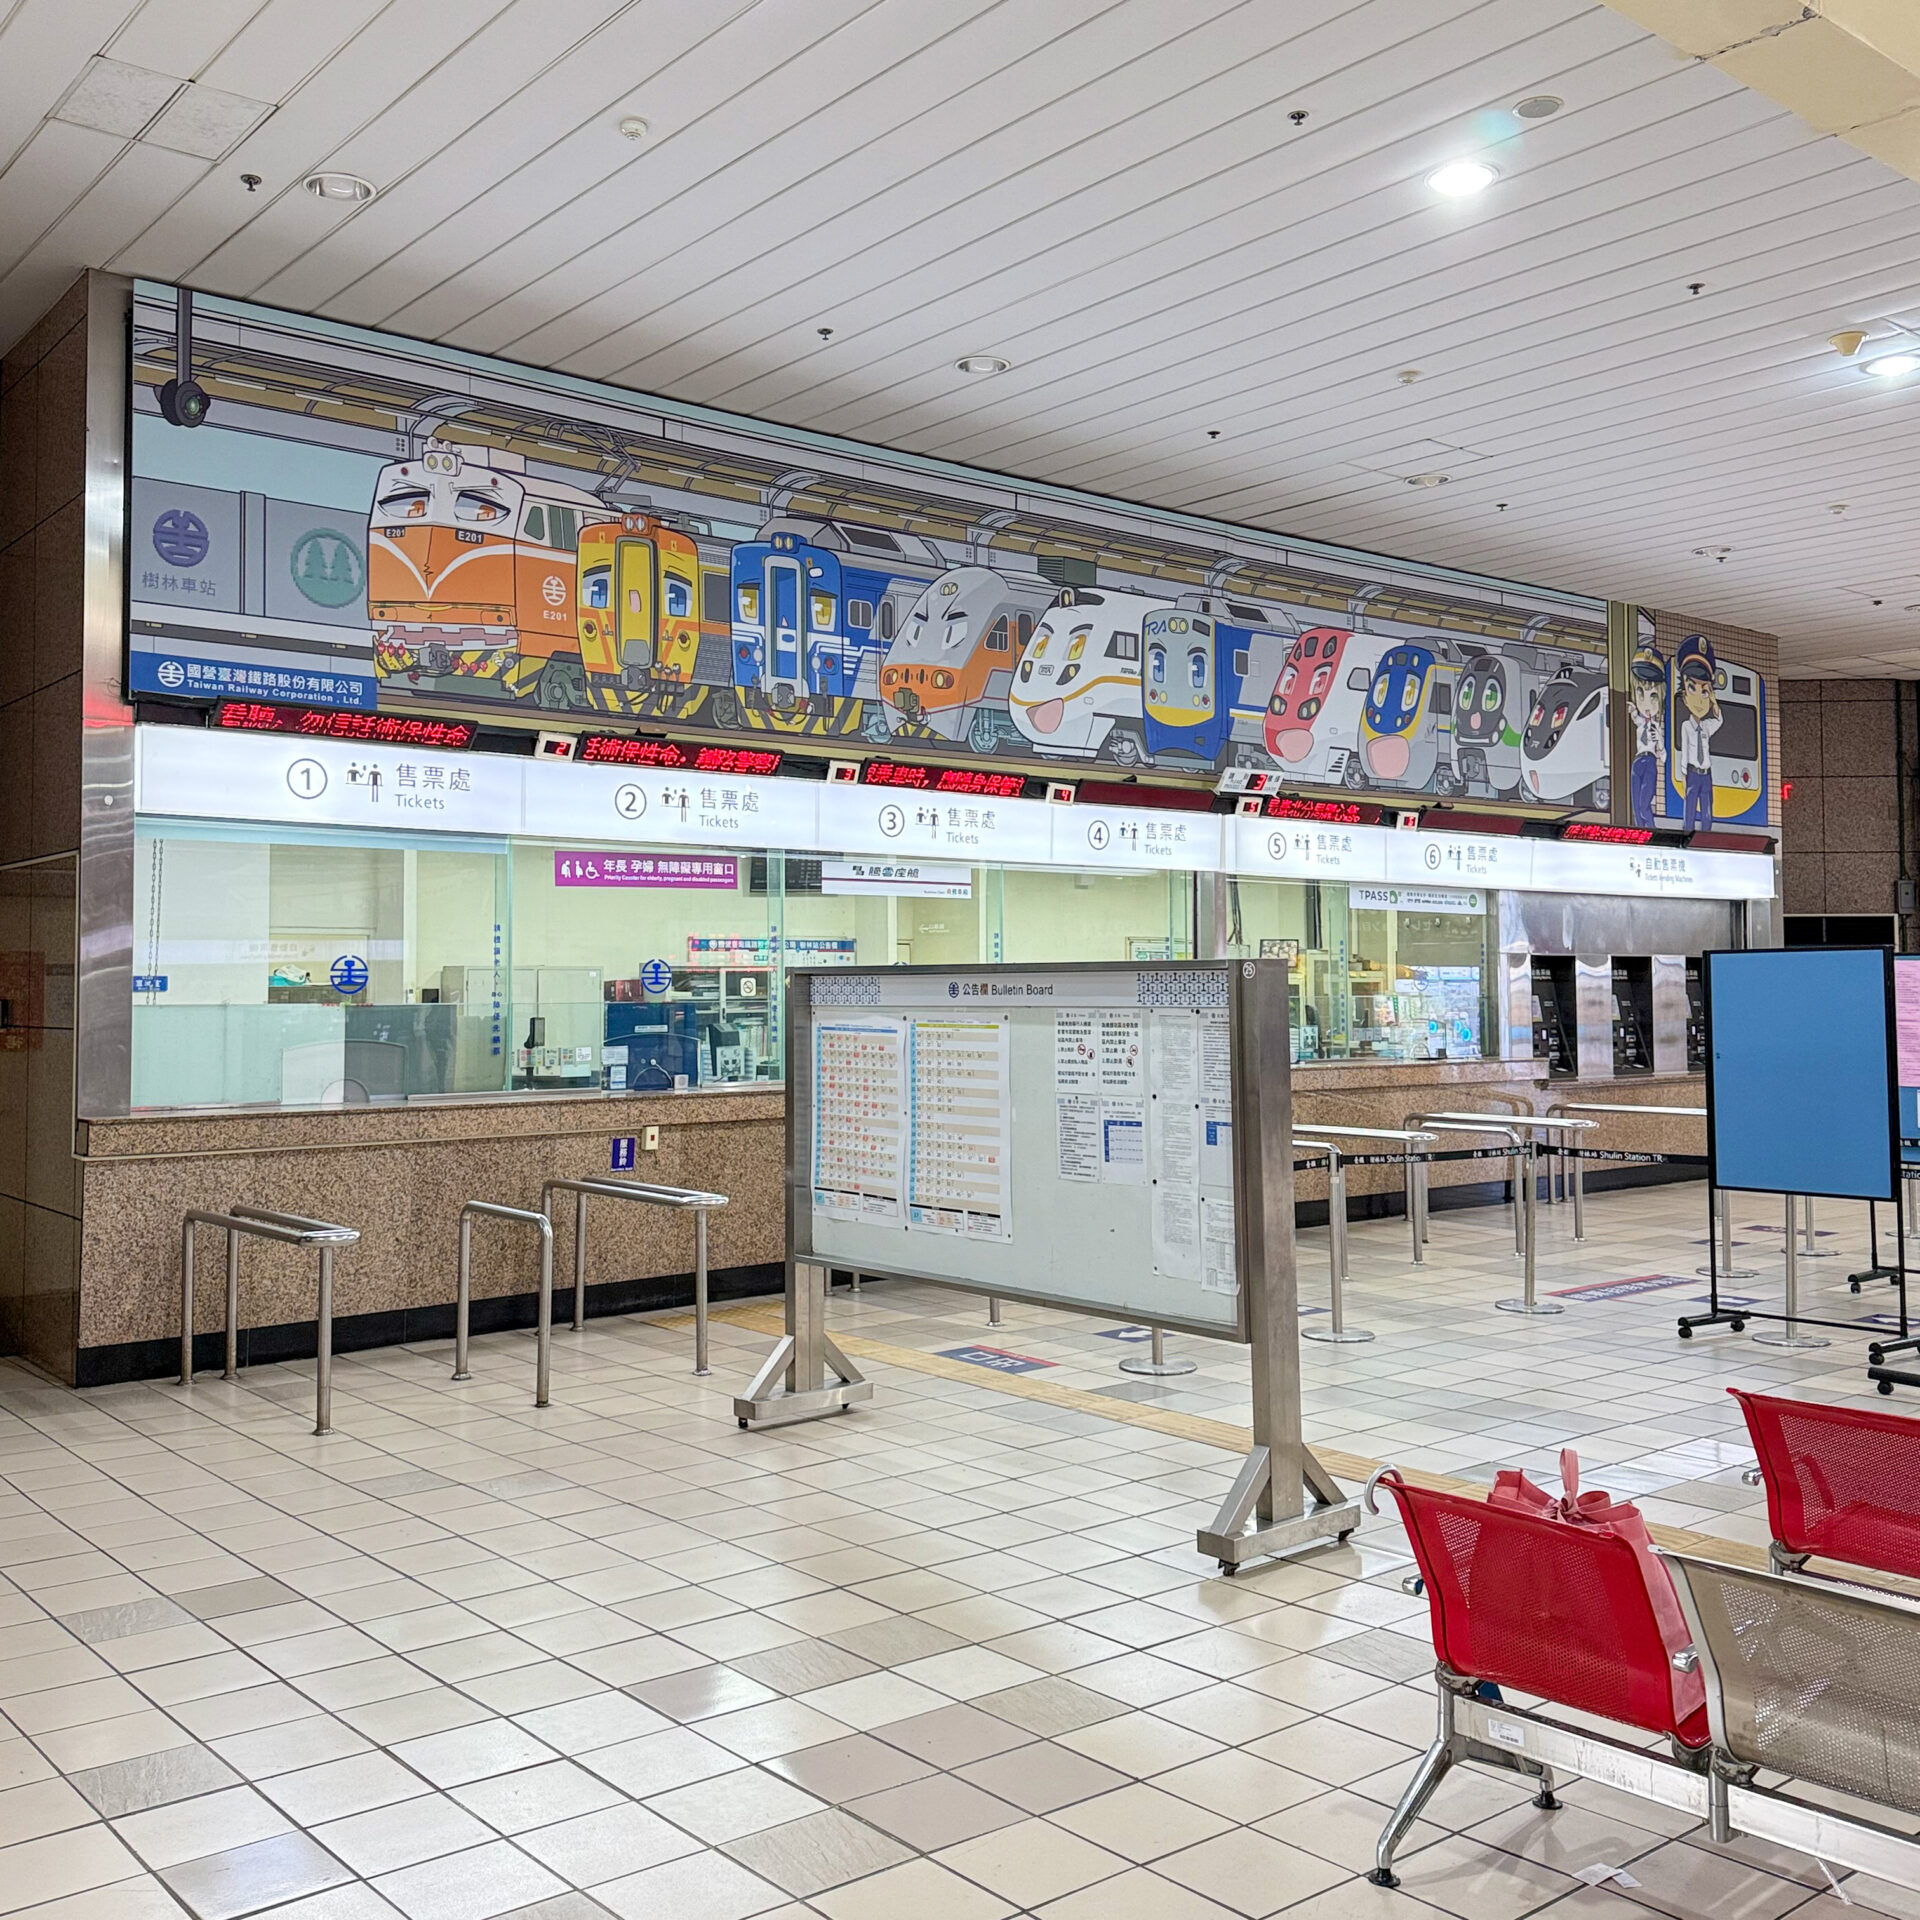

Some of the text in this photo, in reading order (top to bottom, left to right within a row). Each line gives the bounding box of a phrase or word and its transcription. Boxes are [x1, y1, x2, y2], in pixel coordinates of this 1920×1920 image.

[385, 528, 405, 538] E201
[458, 531, 483, 543] E201
[142, 571, 216, 596] 樹林車站
[543, 611, 568, 621] E201
[187, 664, 363, 696] 國營臺灣鐵路股份有限公司
[187, 679, 224, 691] Taiwan
[227, 683, 268, 697] Railway
[272, 688, 333, 702] Corporation
[343, 695, 362, 705] Ltd.
[555, 742, 567, 756] 2
[396, 763, 471, 792] 售票處
[844, 768, 852, 781] 3
[1253, 774, 1267, 790] 3
[395, 793, 445, 810] Tickets
[700, 788, 759, 813] 售票處
[1061, 789, 1069, 801] 4
[1249, 802, 1257, 813] 5
[699, 814, 739, 829] Tickets
[947, 807, 996, 830] 售票處
[946, 831, 979, 845] Tickets
[1145, 822, 1187, 842] 售票處
[1144, 844, 1172, 856] Tickets
[1317, 834, 1352, 852] 售票處
[1316, 854, 1341, 865] Tickets
[1467, 845, 1498, 862] 售票處
[604, 859, 734, 875] 年長 孕婦 無障礙專用窗口
[1466, 864, 1487, 874] Tickets
[1359, 889, 1389, 901] TPASS
[962, 983, 988, 996] 公告欄
[991, 984, 1054, 995] Bulletin Board
[1386, 1154, 1404, 1163] Shulin
[1600, 1150, 1622, 1159] Shulin
[1624, 1152, 1651, 1162] Station
